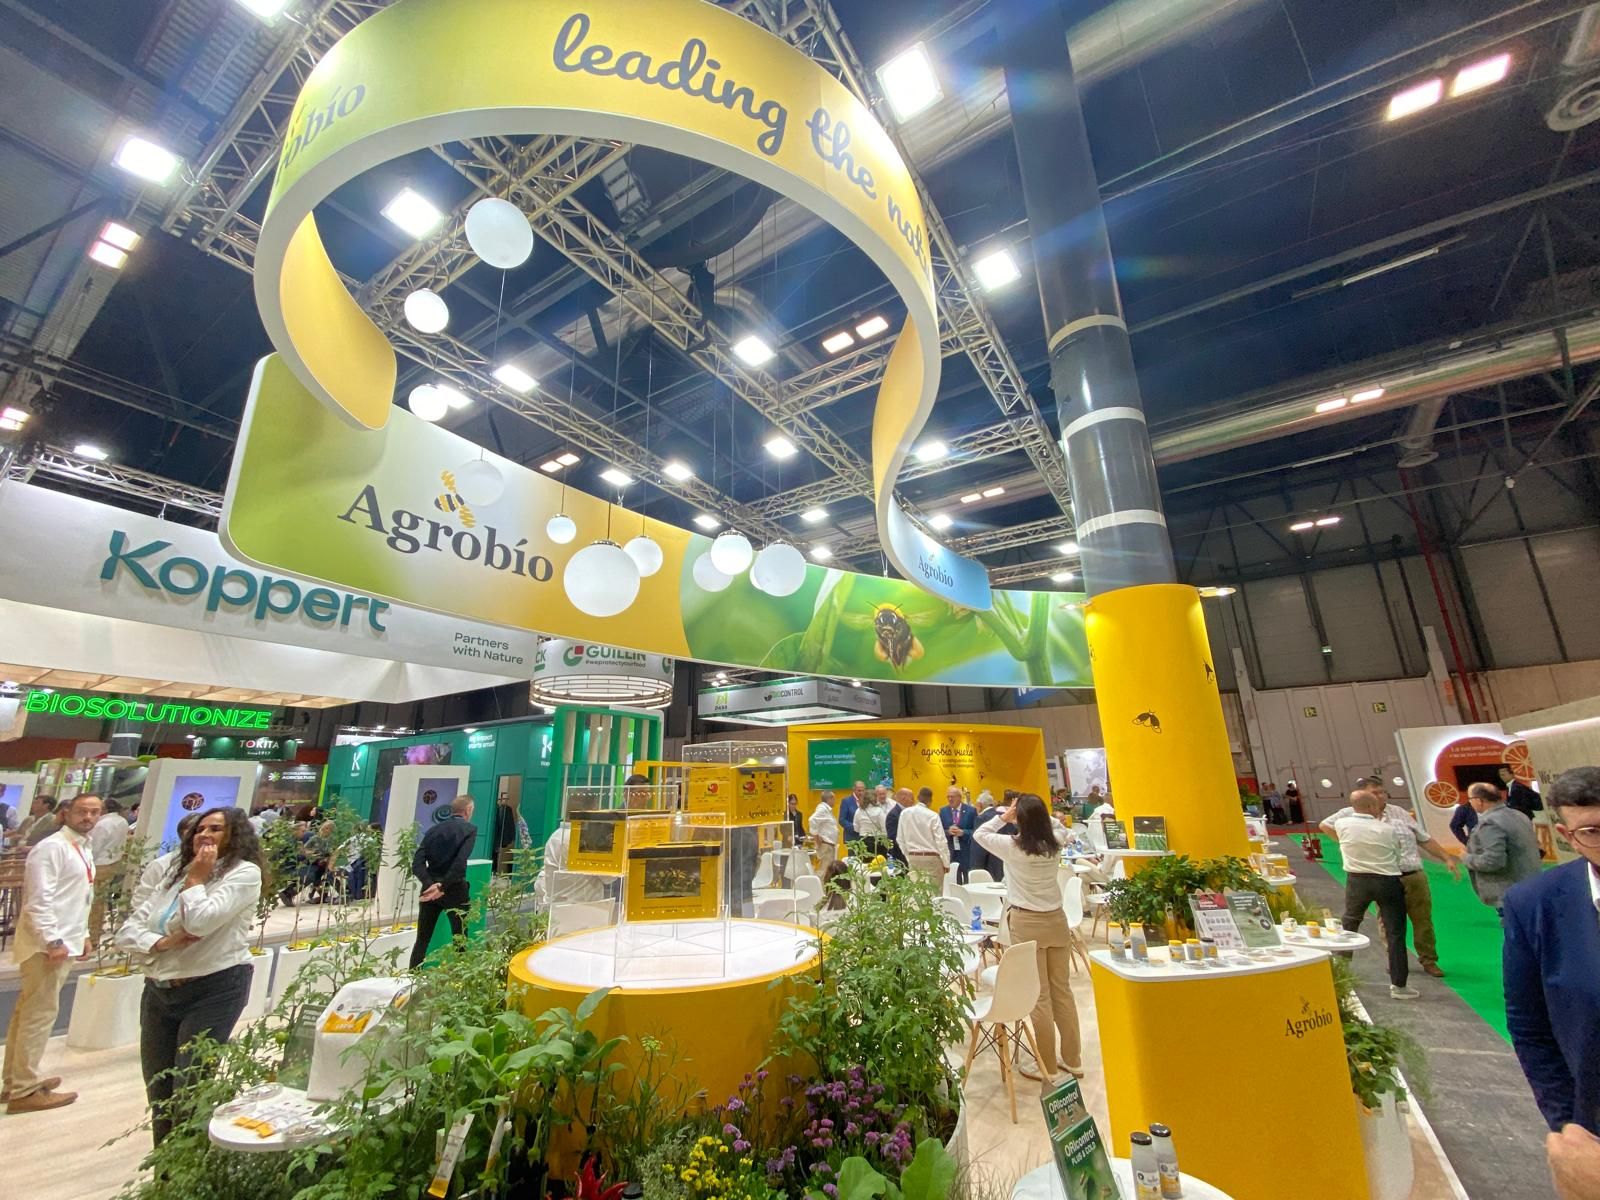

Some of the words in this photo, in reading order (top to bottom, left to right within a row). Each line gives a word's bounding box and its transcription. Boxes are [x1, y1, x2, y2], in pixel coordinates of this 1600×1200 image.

[553, 14, 788, 155] leading
[805, 108, 877, 200] the
[337, 484, 554, 583] Agrobío
[99, 529, 391, 633] Koppert
[453, 645, 480, 658] with
[484, 650, 524, 665] Nature
[454, 632, 510, 650] Partners
[534, 649, 547, 662] CK
[585, 645, 646, 661] GUILLIN
[25, 690, 273, 730] BIOSOLUTIONIZE
[240, 738, 280, 749] TOKITA
[1285, 1007, 1333, 1039] Agrobío
[1064, 1125, 1096, 1157] ORIcontrol
